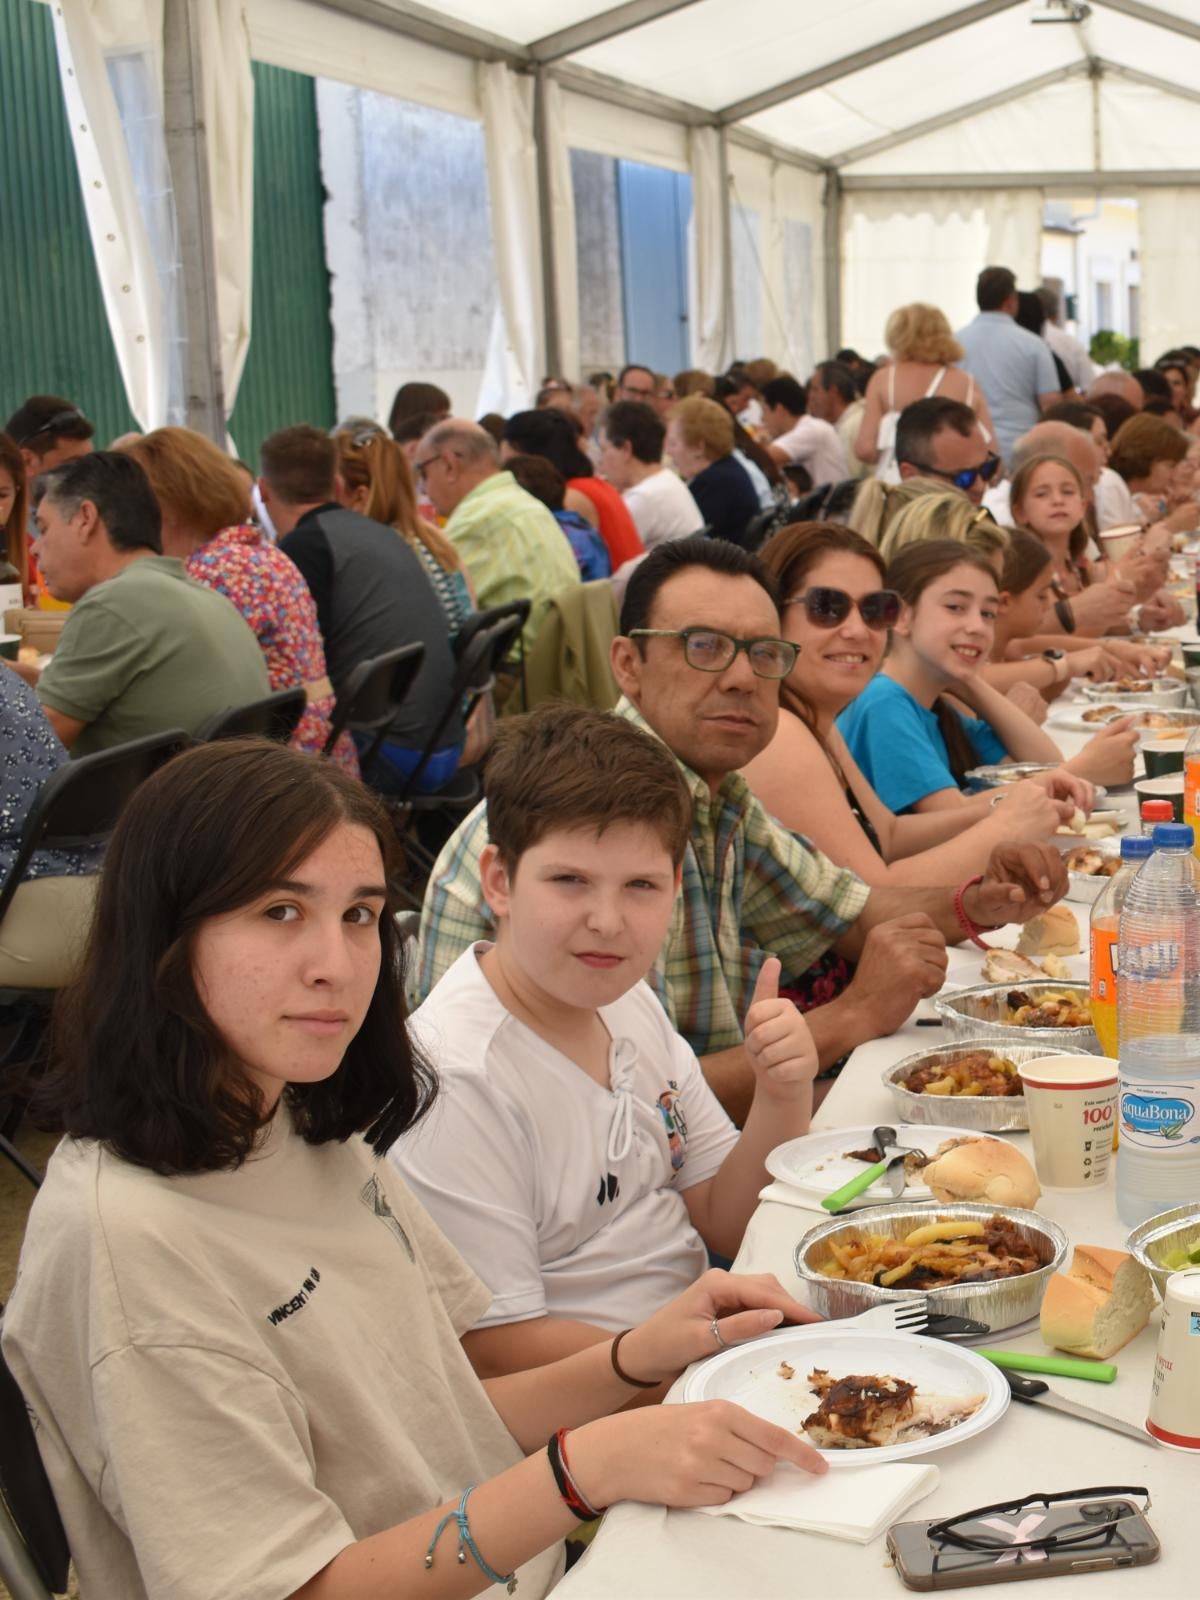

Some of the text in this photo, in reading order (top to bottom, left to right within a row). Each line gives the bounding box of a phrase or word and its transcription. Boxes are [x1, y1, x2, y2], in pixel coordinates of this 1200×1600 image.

[1083, 1105, 1112, 1125] 100
[1123, 1102, 1187, 1120] aquaBona
[267, 1290, 310, 1327] VINCENT
